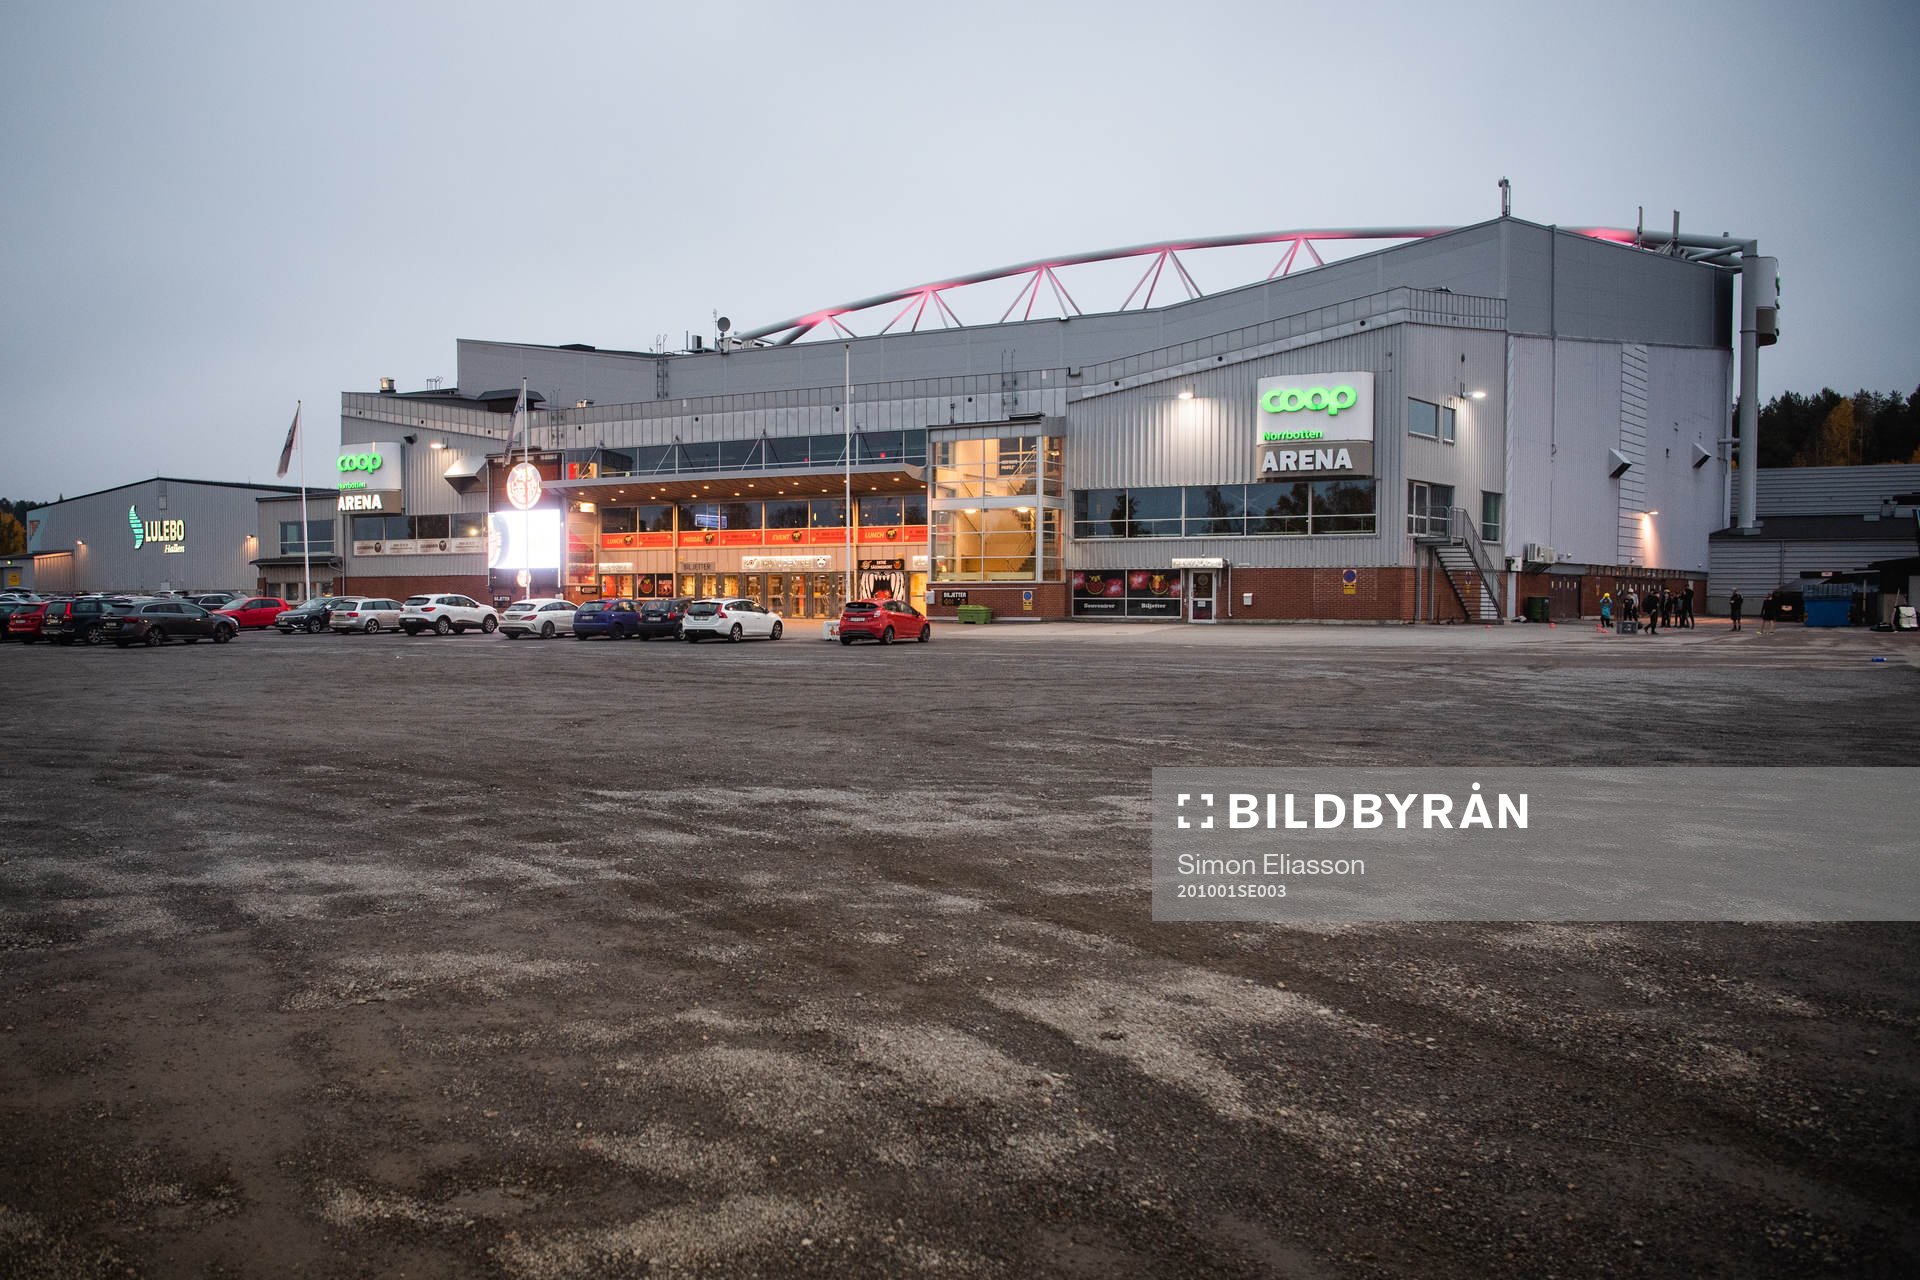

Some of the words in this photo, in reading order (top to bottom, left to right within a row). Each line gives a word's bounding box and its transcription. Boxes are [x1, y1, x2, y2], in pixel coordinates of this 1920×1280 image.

[1261, 385, 1357, 416] coop
[1263, 430, 1323, 441] Norrbotten
[336, 452, 382, 474] coop
[1261, 448, 1353, 472] ARENA
[337, 494, 383, 511] ARENA
[145, 519, 185, 542] LULEBO
[164, 544, 185, 553] Hallen
[683, 562, 711, 571] BILJETTER
[1141, 602, 1167, 610] Biljetter
